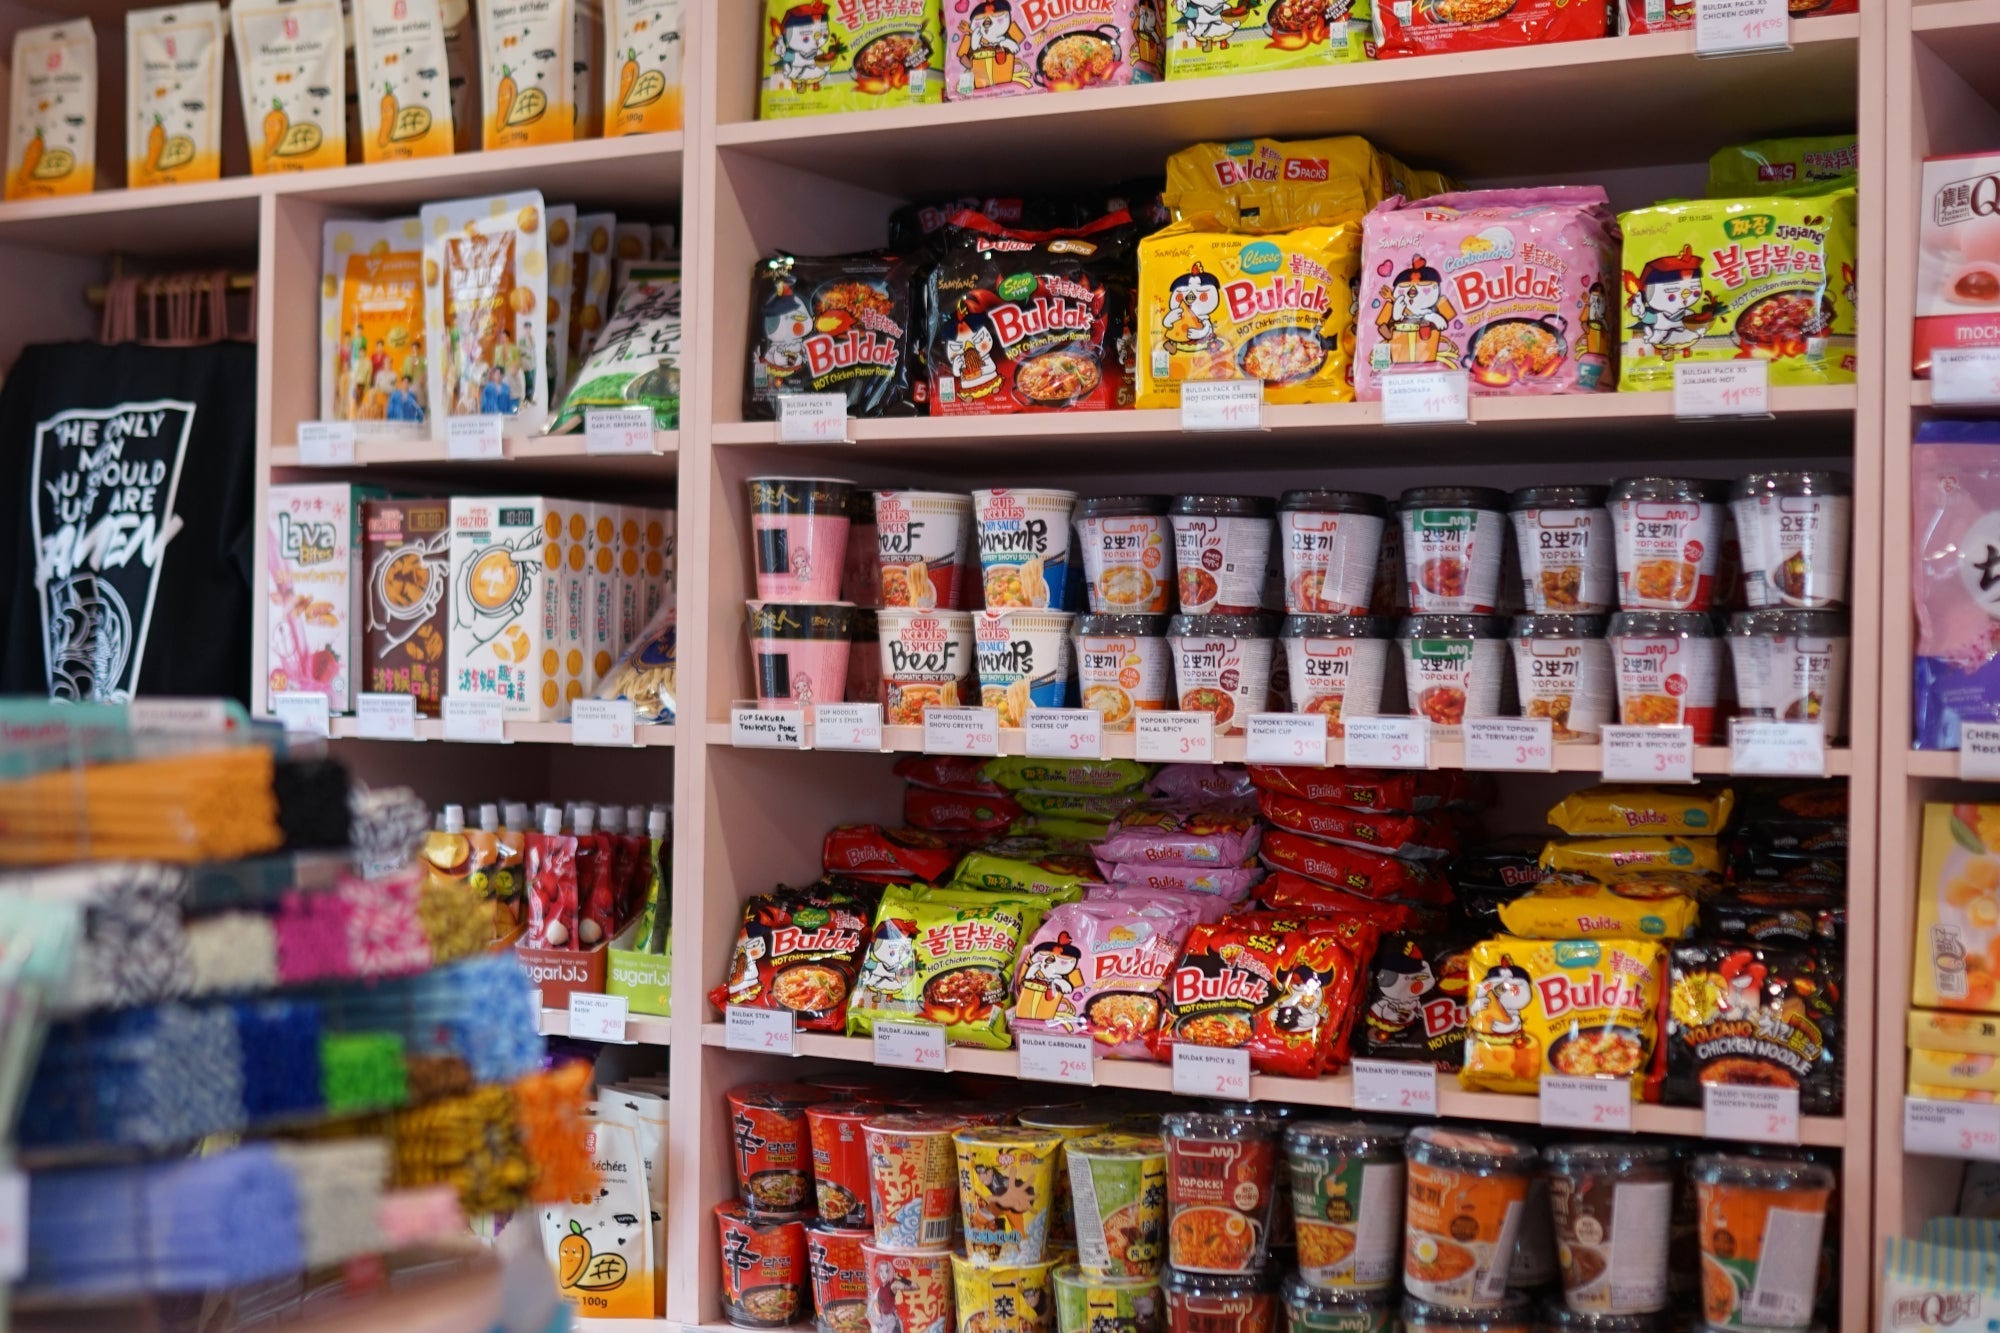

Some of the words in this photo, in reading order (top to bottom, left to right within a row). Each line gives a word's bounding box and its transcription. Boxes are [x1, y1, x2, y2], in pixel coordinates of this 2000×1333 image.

[1702, 9, 1737, 21] CHICKEN
[1738, 8, 1765, 18] CURRY
[1742, 18, 1783, 39] 11€95
[1213, 159, 1280, 188] Buldak
[1731, 217, 1770, 236] 짜장
[1775, 224, 1825, 245] Jjajang
[1378, 236, 1421, 249] SAMYANG
[1241, 249, 1282, 271] Cheese
[1443, 249, 1515, 274] Carbonara
[1710, 244, 1824, 289] 불닭볶음면
[1001, 278, 1031, 295] Stew
[1452, 264, 1564, 314] Buldak
[1224, 277, 1330, 323] Buldak
[1731, 293, 1750, 311] HOT
[1750, 283, 1779, 299] Chicken
[988, 297, 1093, 348] Buldak
[1237, 323, 1254, 337] HOT
[1255, 317, 1280, 331] Chicken
[1281, 314, 1304, 325] Flavor
[1466, 313, 1486, 328] HOT
[803, 330, 900, 377] Buldak
[1005, 344, 1023, 361] HOT
[1022, 337, 1048, 352] Chicken
[1069, 332, 1092, 343] Ramen
[812, 375, 830, 391] HOT
[830, 368, 855, 382] Chicken
[855, 367, 875, 377] Flavor
[1201, 394, 1230, 402] CHICKEN
[1231, 393, 1258, 401] CHEESE
[109, 487, 156, 513] ARE
[881, 500, 901, 512] CUP
[990, 497, 1015, 510] CUP
[983, 507, 1025, 521] NOODLES
[998, 520, 1022, 531] SAUCE
[1635, 522, 1678, 538] 요뽀끼
[279, 511, 337, 562] Lava
[1103, 535, 1141, 550] 요뽀끼
[1291, 534, 1334, 551] 요뽀끼
[1422, 528, 1461, 543] 요뽀끼
[1539, 531, 1588, 549] 요뽀끼
[298, 546, 333, 567] Bites
[998, 553, 1018, 562] SHOYU
[910, 618, 939, 632] CUP
[901, 629, 948, 641] NOODLES
[911, 641, 943, 653] SPICES
[1084, 653, 1117, 669] 요뽀끼
[1182, 654, 1217, 669] 요뽀끼
[1304, 659, 1349, 676] 요뽀끼
[1420, 656, 1458, 672] 요뽀끼
[1531, 660, 1578, 677] 요뽀끼
[1622, 657, 1657, 673] 요뽀끼
[894, 673, 922, 682] AROMATIC
[922, 673, 940, 682] SPICY
[1182, 670, 1217, 678] YOPOKKI
[1419, 672, 1459, 681] YOPOKKI
[754, 714, 786, 723] SAKURA
[929, 713, 941, 721] CUP
[942, 713, 973, 722] NOODLES
[1030, 714, 1060, 723] YOPOKKI
[1060, 714, 1089, 722] TOPOKKI
[1140, 717, 1170, 725] YOPOKKI
[1171, 717, 1200, 725] TOPOKKI
[1252, 719, 1283, 727] YOPOKKI
[1284, 719, 1315, 728] TOPOKKI
[739, 723, 777, 732] TONKOTSU
[778, 724, 797, 733] PORC
[929, 721, 946, 729] SHOYU
[948, 722, 984, 730] CREVETTE
[1030, 722, 1055, 730] CHEESE
[1056, 722, 1069, 730] CUP
[1252, 727, 1277, 735] KIMCHI
[1278, 727, 1292, 735] CUP
[1471, 724, 1505, 732] YOPOKKI
[1506, 725, 1538, 733] TOPOKKI
[852, 728, 877, 743] 2€50
[965, 733, 993, 749] 2€50
[1069, 734, 1096, 750] 3€10
[1349, 732, 1380, 740] TOPOKKI
[1381, 732, 1409, 741] TOMATE
[1485, 733, 1518, 741] TERIYAKI
[1519, 733, 1535, 741] CUP
[1179, 737, 1206, 753] 3€10
[1624, 809, 1669, 828] Buldak
[1145, 848, 1183, 862] Buldak
[1032, 882, 1050, 893] HOT
[1148, 875, 1185, 890] Buldak
[1576, 915, 1623, 933] Buldak
[771, 926, 860, 957] Buldak
[919, 921, 1018, 959] 불닭볶음면
[1246, 935, 1275, 954] Spicy
[771, 956, 788, 967] HOT
[927, 959, 944, 973] HOT
[944, 955, 972, 968] Chicken
[1173, 965, 1270, 1006] Buldak
[1536, 973, 1646, 1019] Buldak
[731, 1011, 754, 1019] BULDAK
[755, 1012, 771, 1020] STEW
[1179, 1003, 1195, 1014] HOT
[731, 1019, 755, 1027] RAGOUT
[765, 1031, 789, 1047] 2€65
[878, 1026, 901, 1035] BULDAK
[902, 1028, 930, 1037] JJAJANG
[1682, 1019, 1752, 1047] VOLCANO
[1022, 1038, 1047, 1048] BULDAK
[1048, 1040, 1087, 1049] CARBONARA
[1428, 1032, 1447, 1051] HOT
[915, 1047, 940, 1063] 2€65
[1178, 1053, 1203, 1062] BULDAK
[1205, 1055, 1225, 1064] SPICY
[1697, 1037, 1760, 1060] CHICKEN
[1758, 1042, 1813, 1077] NOODLE
[1060, 1060, 1087, 1076] 2€65
[1355, 1066, 1383, 1075] BULDAK
[1384, 1068, 1400, 1076] HOT
[1401, 1069, 1433, 1078] CHICKEN
[1216, 1075, 1244, 1092] 2€65
[1547, 1081, 1577, 1090] BULDAK
[1578, 1082, 1608, 1092] CHEESE
[1400, 1089, 1431, 1107] 2€65
[733, 1111, 766, 1177] 辛
[766, 1140, 798, 1154] 라면
[591, 1159, 627, 1173] séchées
[1178, 1176, 1224, 1190] YOPOKKI
[723, 1226, 762, 1293] 辛
[762, 1269, 777, 1277] SHIN
[808, 1239, 838, 1305] 辛
[840, 1283, 855, 1291] SHIN
[581, 1296, 608, 1309] 100g
